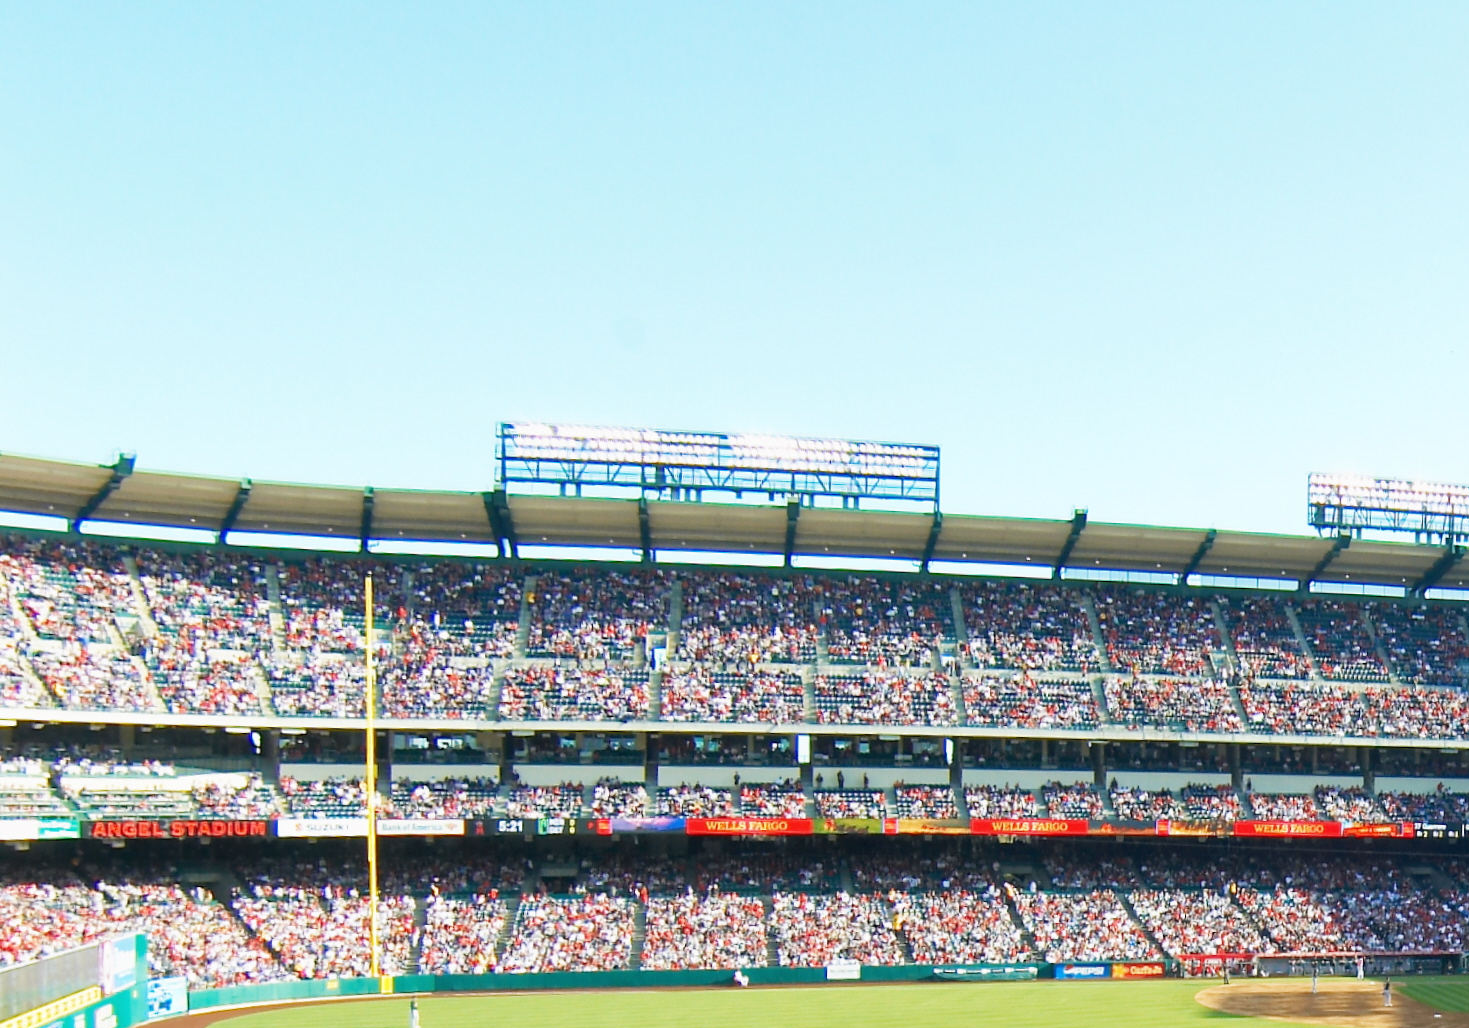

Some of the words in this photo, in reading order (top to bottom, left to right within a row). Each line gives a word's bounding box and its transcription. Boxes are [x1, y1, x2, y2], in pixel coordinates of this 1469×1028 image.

[93, 821, 164, 837] ANGEL
[170, 821, 266, 837] STADIUM
[382, 823, 400, 831] Bank
[412, 823, 443, 831] America
[498, 820, 523, 832] 5:21
[706, 821, 745, 831] WELLS
[748, 821, 788, 831] FARGO
[992, 822, 1030, 832] WELLS
[1032, 822, 1068, 832] FARGO
[1254, 824, 1288, 834] WELLS
[1290, 824, 1324, 834] FARGO
[1076, 966, 1105, 975] PEPSI
